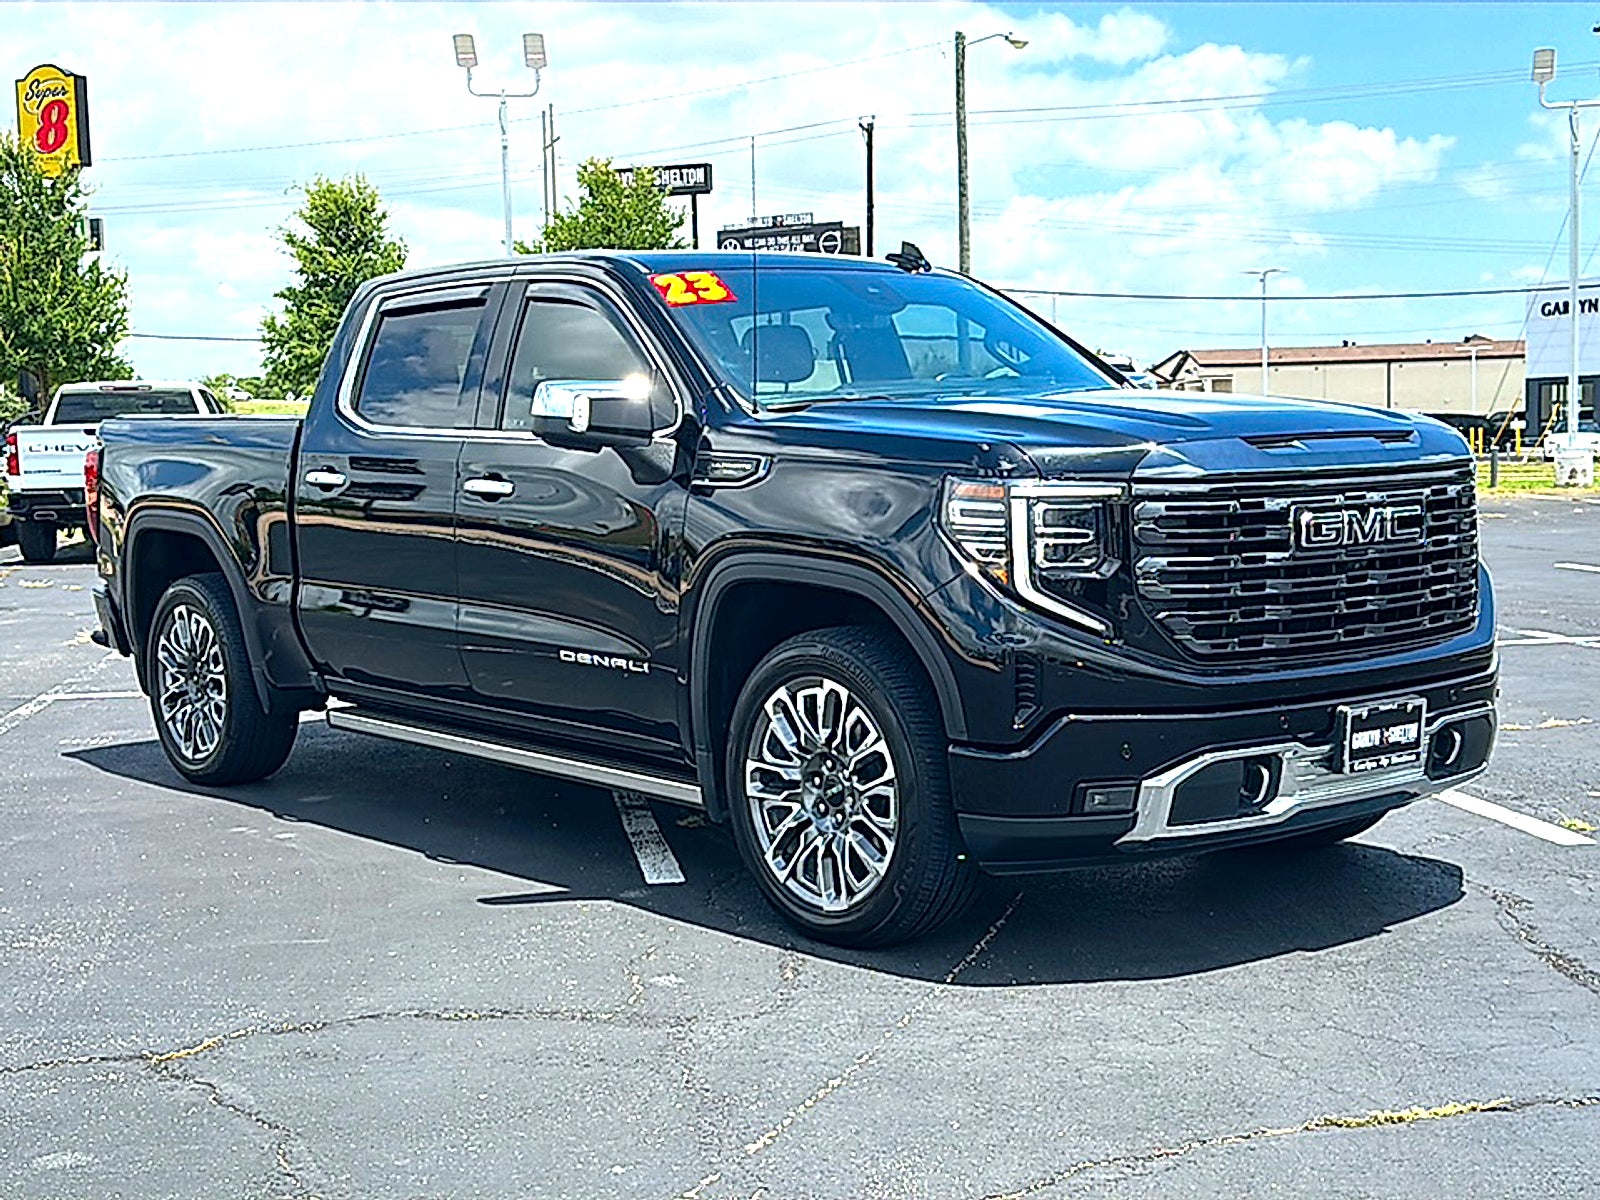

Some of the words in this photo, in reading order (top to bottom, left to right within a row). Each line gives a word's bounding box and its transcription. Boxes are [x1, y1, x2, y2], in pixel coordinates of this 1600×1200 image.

[25, 78, 69, 111] Super
[36, 99, 70, 154] 8
[652, 167, 705, 186] SHELTON
[653, 271, 728, 304] 23
[1541, 298, 1599, 317] GARYN
[1300, 505, 1421, 547] GMC
[559, 649, 650, 674] DENALI
